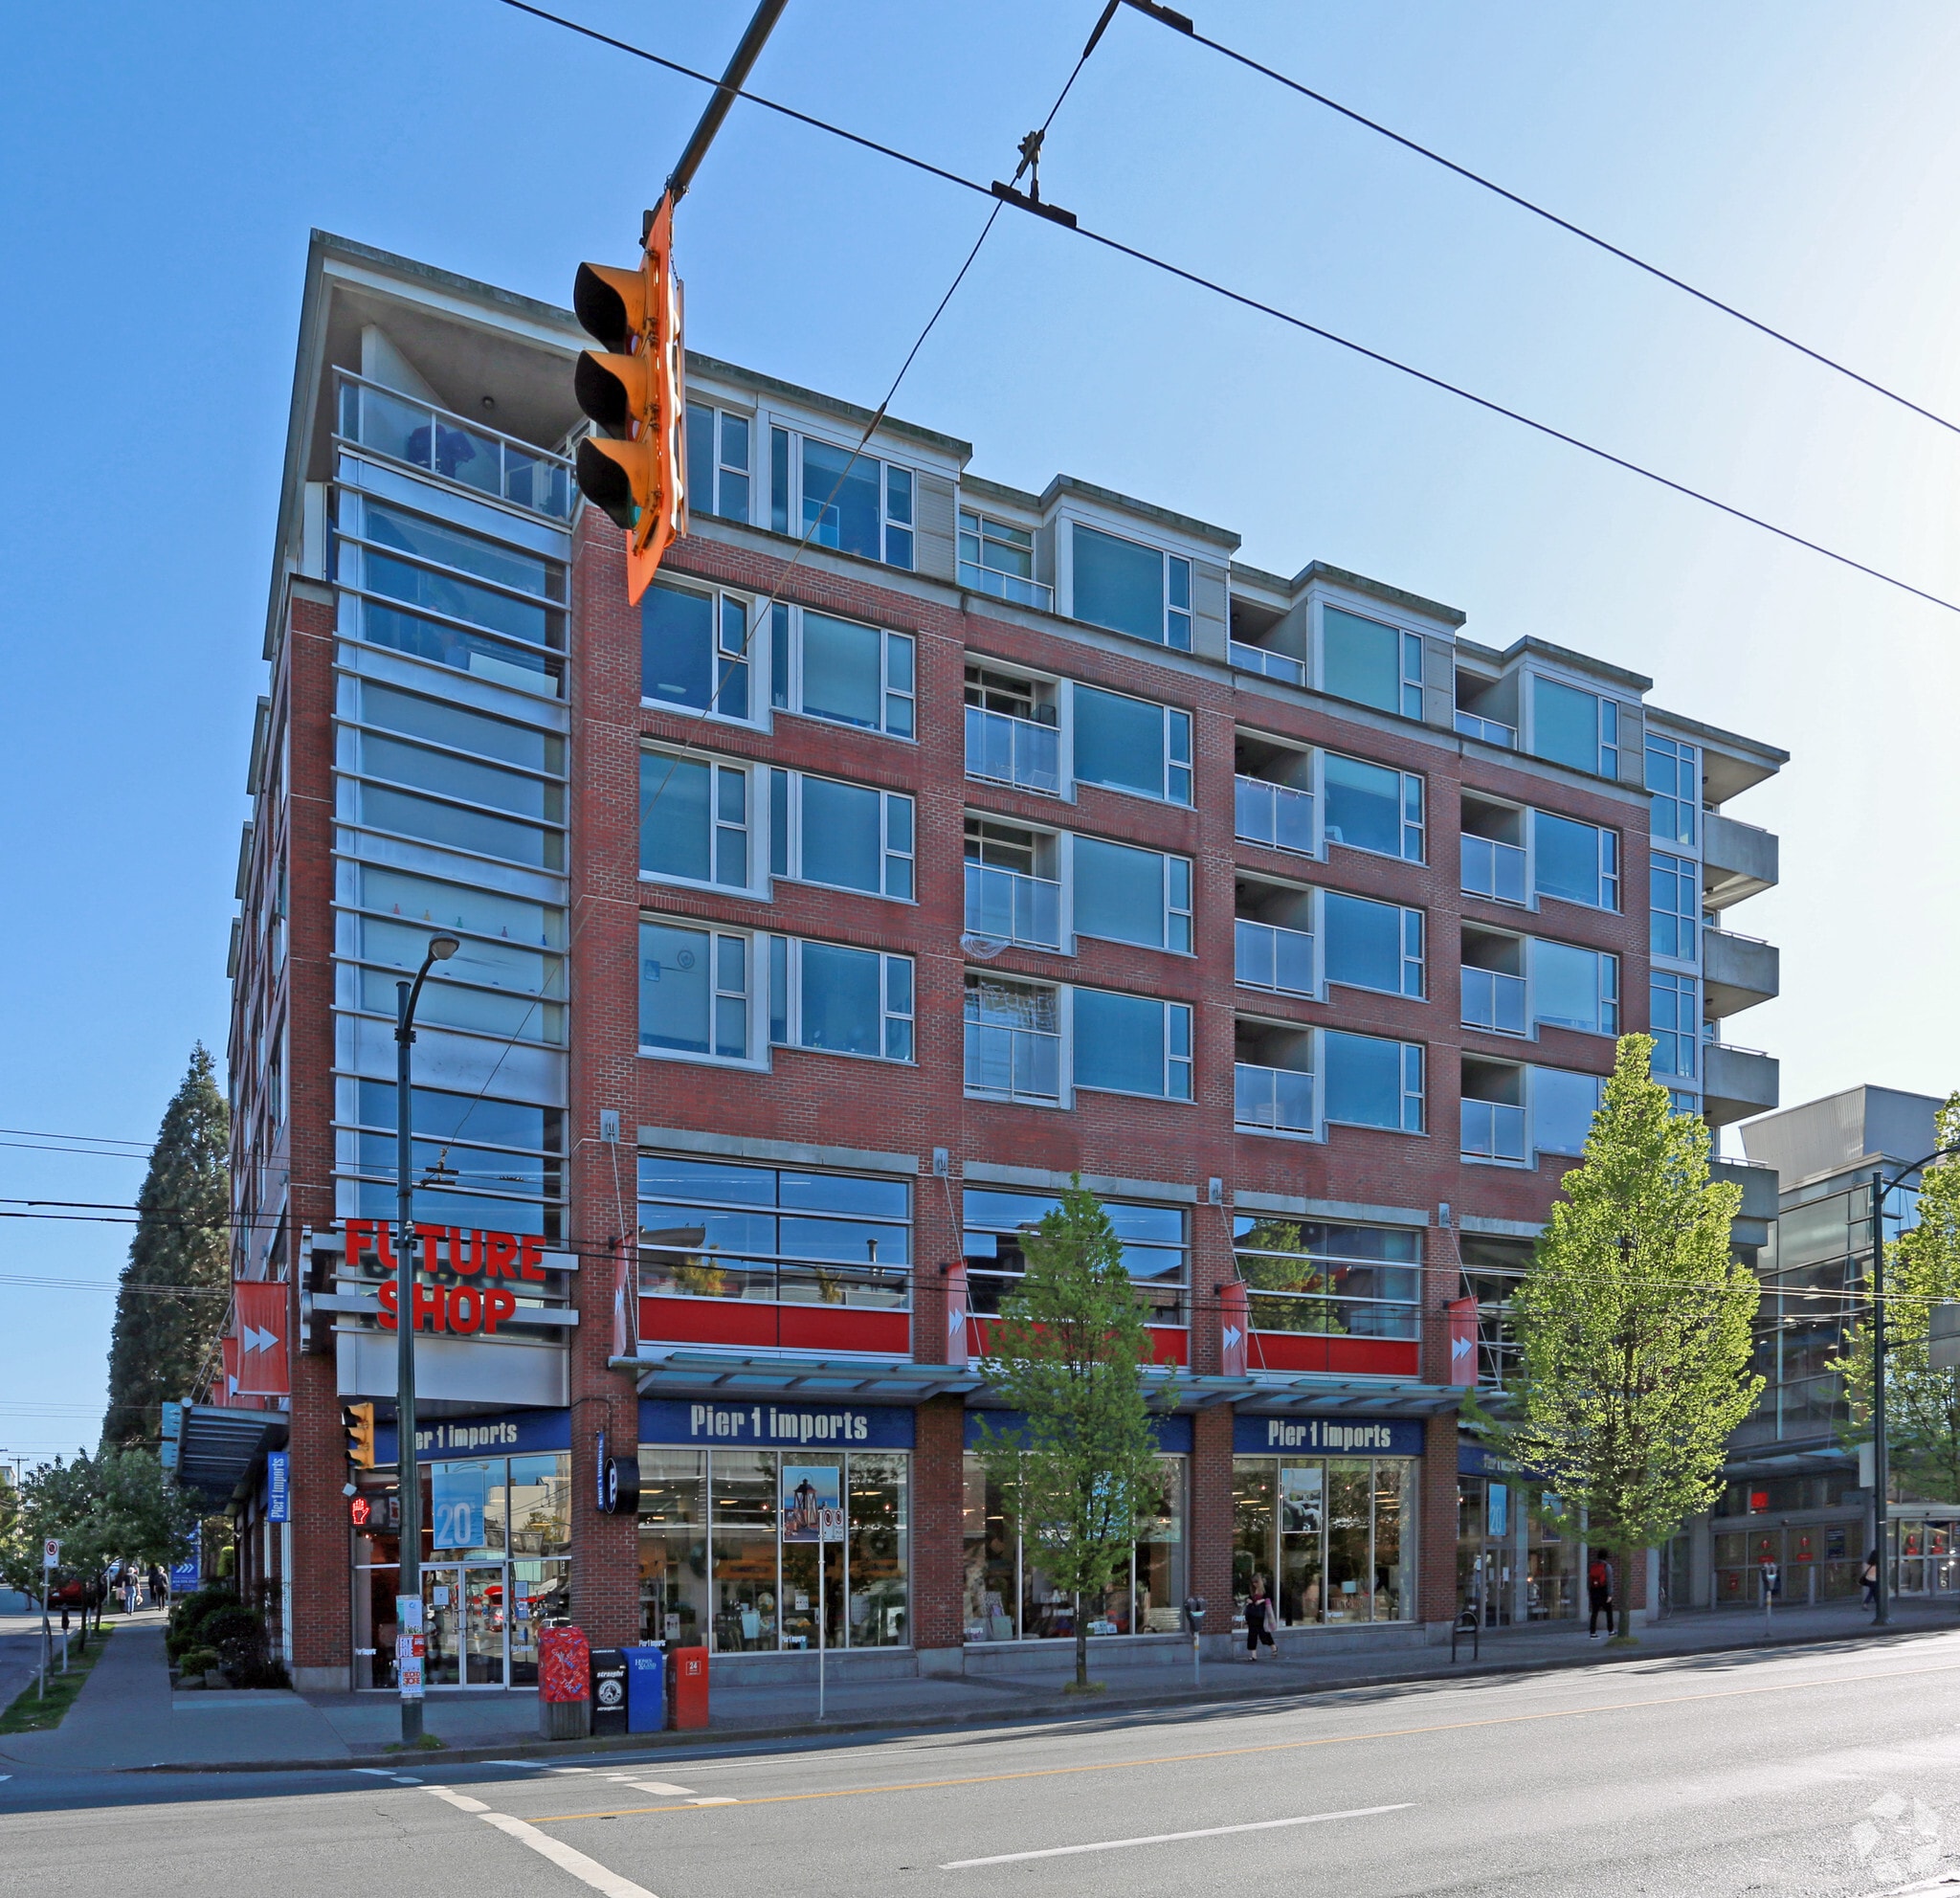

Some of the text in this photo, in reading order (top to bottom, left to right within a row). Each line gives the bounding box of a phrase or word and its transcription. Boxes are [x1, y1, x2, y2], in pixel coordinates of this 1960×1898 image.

[345, 1218, 546, 1281] FUTURE
[376, 1280, 516, 1334] SHOP
[415, 1422, 517, 1450] er 1 imports
[690, 1404, 868, 1443] Pier 1 imports
[1268, 1419, 1391, 1452] Pier 1 imports
